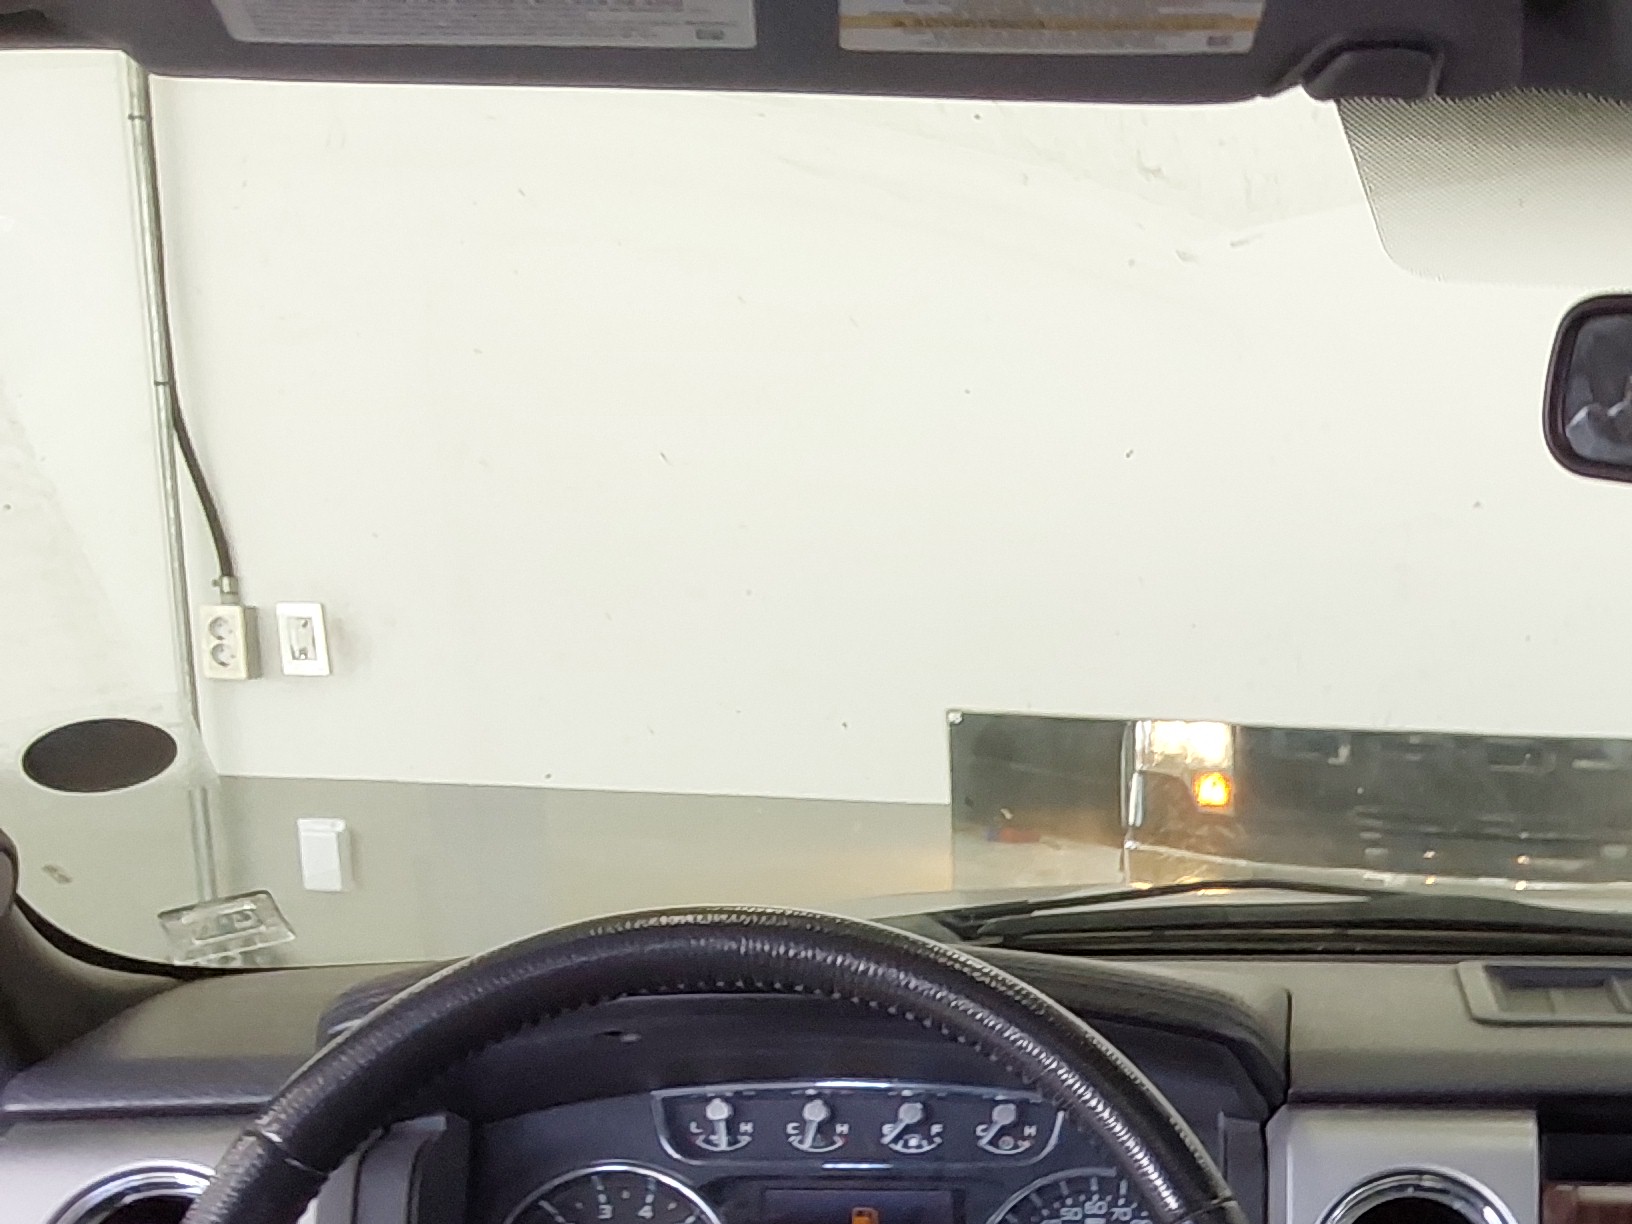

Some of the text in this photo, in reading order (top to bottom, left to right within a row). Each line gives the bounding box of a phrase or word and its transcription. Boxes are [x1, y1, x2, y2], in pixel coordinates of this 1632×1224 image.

[598, 1204, 613, 1219] 3
[638, 1204, 653, 1219] 4
[1109, 1207, 1132, 1221] 70
